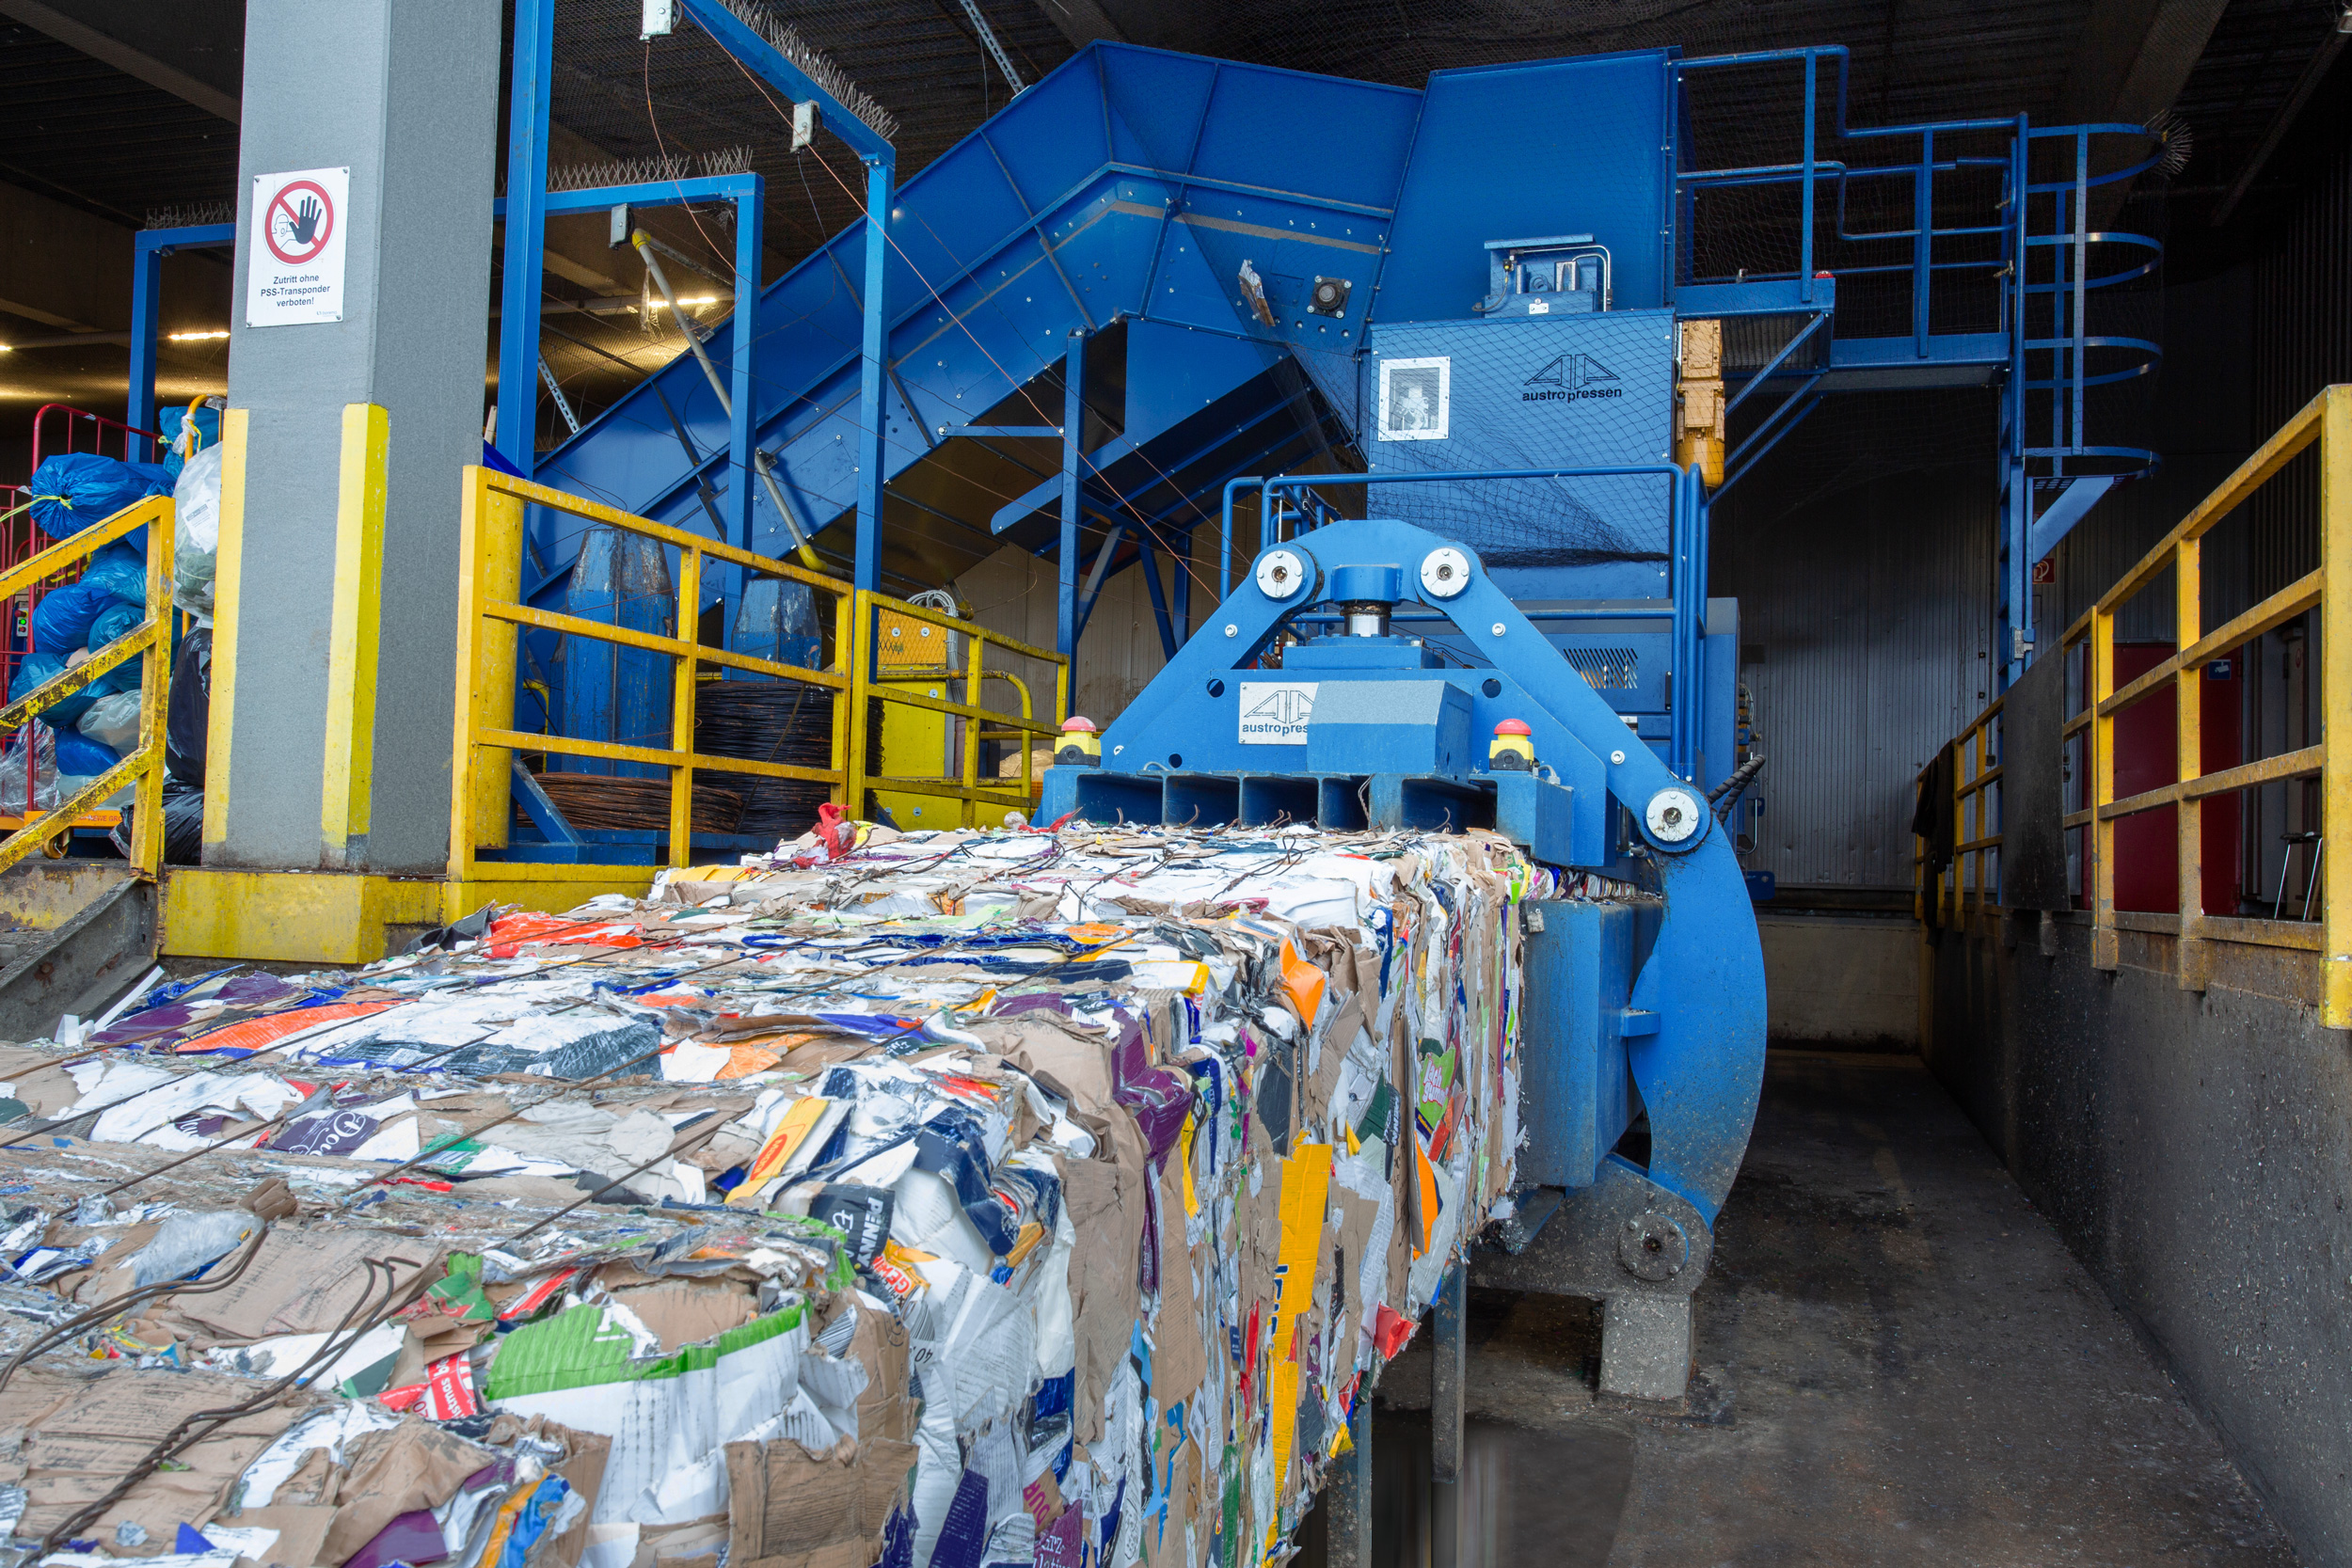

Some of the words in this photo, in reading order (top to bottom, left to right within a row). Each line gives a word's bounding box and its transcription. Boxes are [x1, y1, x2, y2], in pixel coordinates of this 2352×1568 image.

[273, 275, 297, 285] Zutritt
[299, 274, 320, 283] ohne
[261, 285, 330, 297] PSS-Transponder
[277, 296, 314, 308] verboten!
[1242, 722, 1308, 737] austropres
